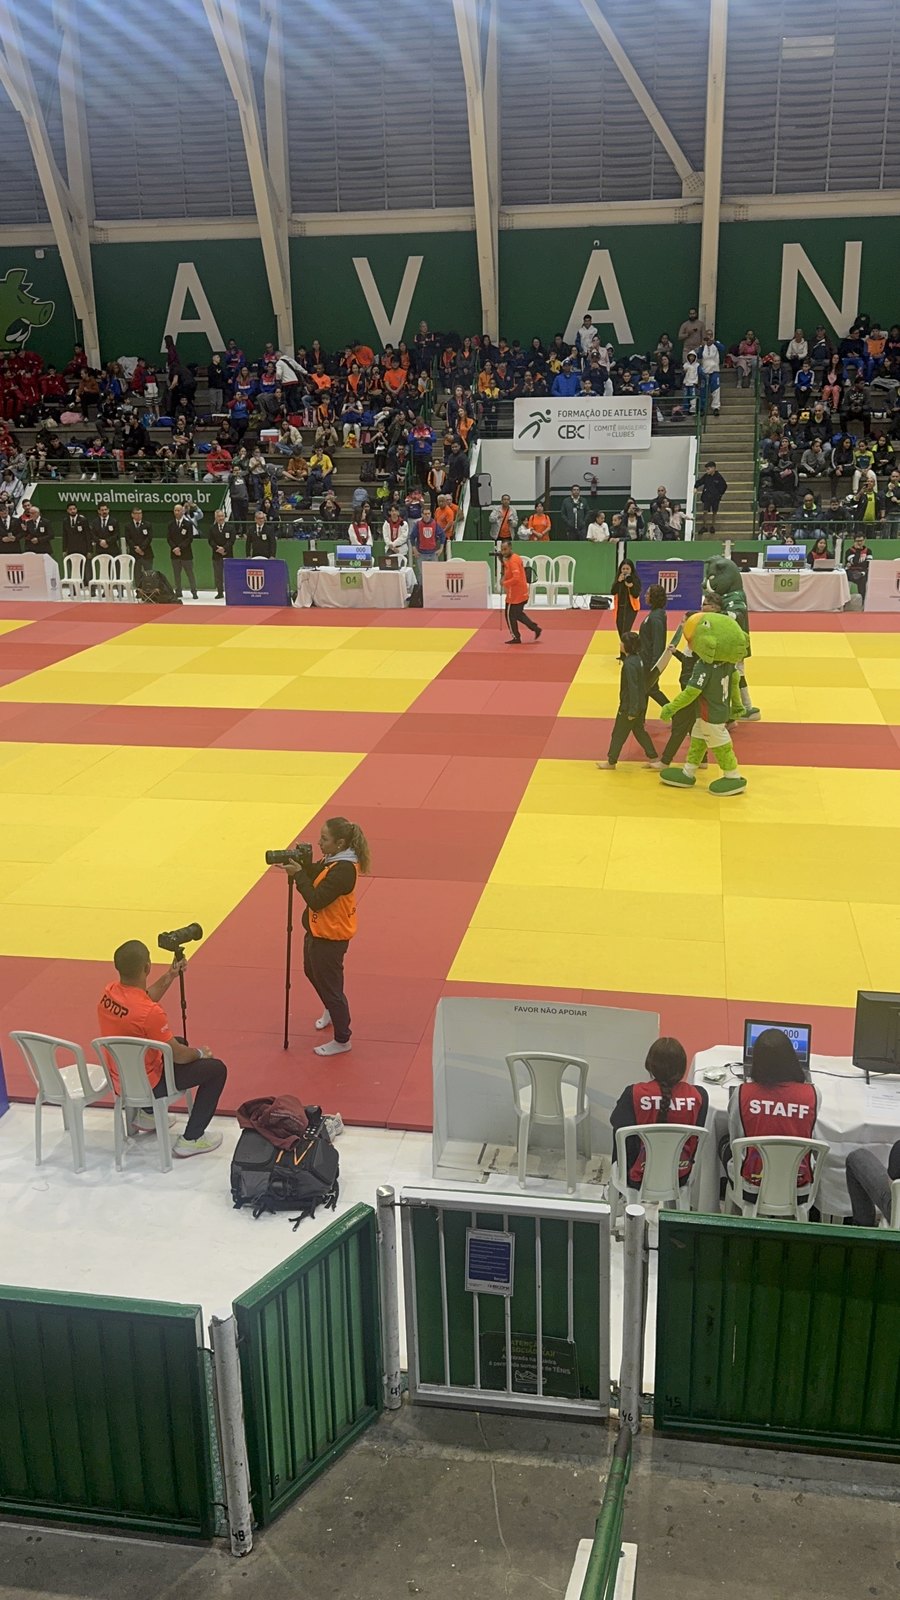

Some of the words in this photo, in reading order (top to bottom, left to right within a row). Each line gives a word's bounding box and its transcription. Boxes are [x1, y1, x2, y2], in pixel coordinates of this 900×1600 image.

[557, 408, 601, 419] FORMAÇÃO
[602, 409, 613, 417] DE
[614, 408, 648, 417] ATLETAS
[557, 424, 586, 440] CBC
[58, 489, 211, 506] www.palmeiras.com.br
[345, 575, 357, 585] 04
[780, 578, 793, 588] 06
[514, 1005, 539, 1014] FAVOR
[540, 1006, 557, 1015] NÃO
[558, 1008, 588, 1017] APOIAR
[749, 1099, 810, 1119] STAFF
[622, 1410, 633, 1422] 46
